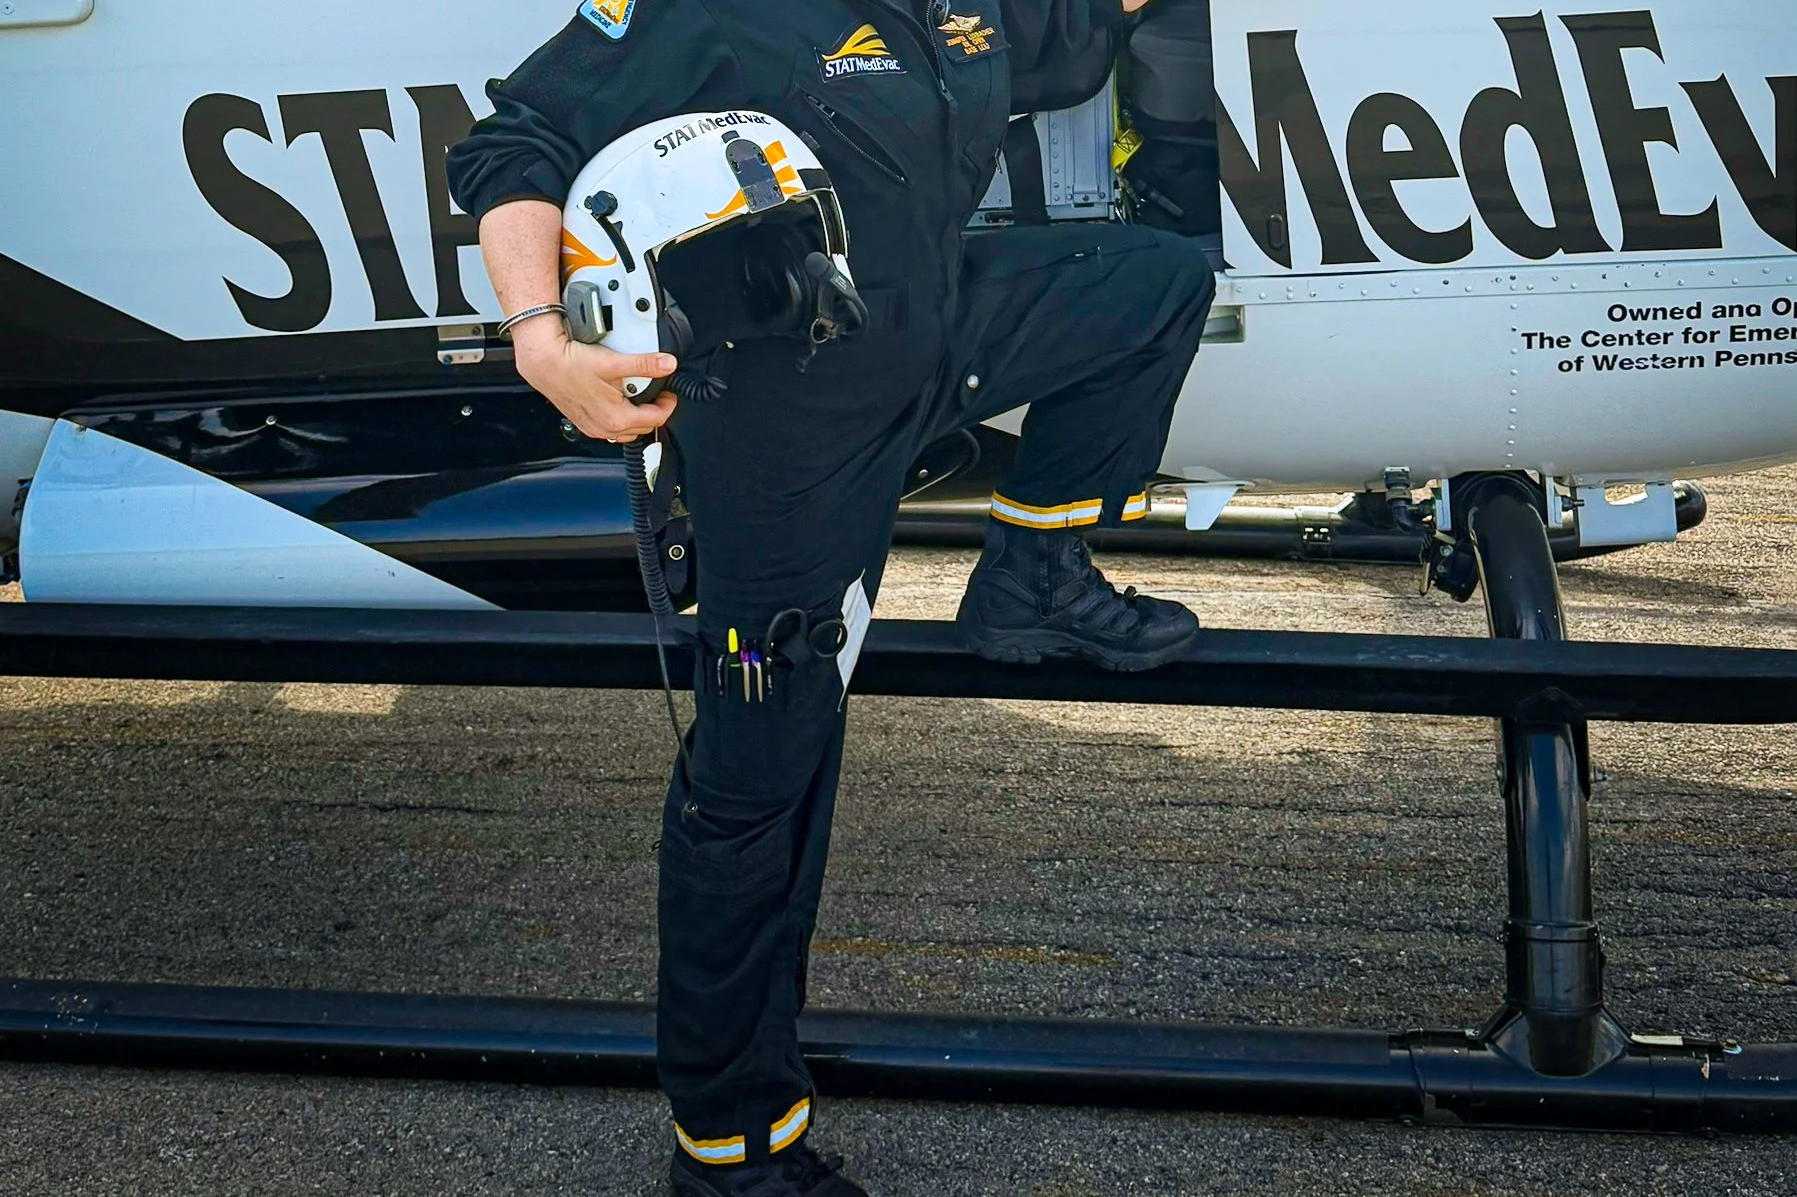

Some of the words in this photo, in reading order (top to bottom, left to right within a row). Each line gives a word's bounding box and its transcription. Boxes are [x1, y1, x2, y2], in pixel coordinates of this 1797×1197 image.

[182, 83, 481, 332] STA
[1607, 301, 1702, 323] Owned
[1771, 296, 1797, 319] O
[1521, 332, 1572, 350] The
[1580, 328, 1674, 348] Center
[1681, 326, 1721, 345] for
[1557, 356, 1585, 373] of
[1592, 353, 1705, 372] Western
[1714, 350, 1797, 369] Penns
